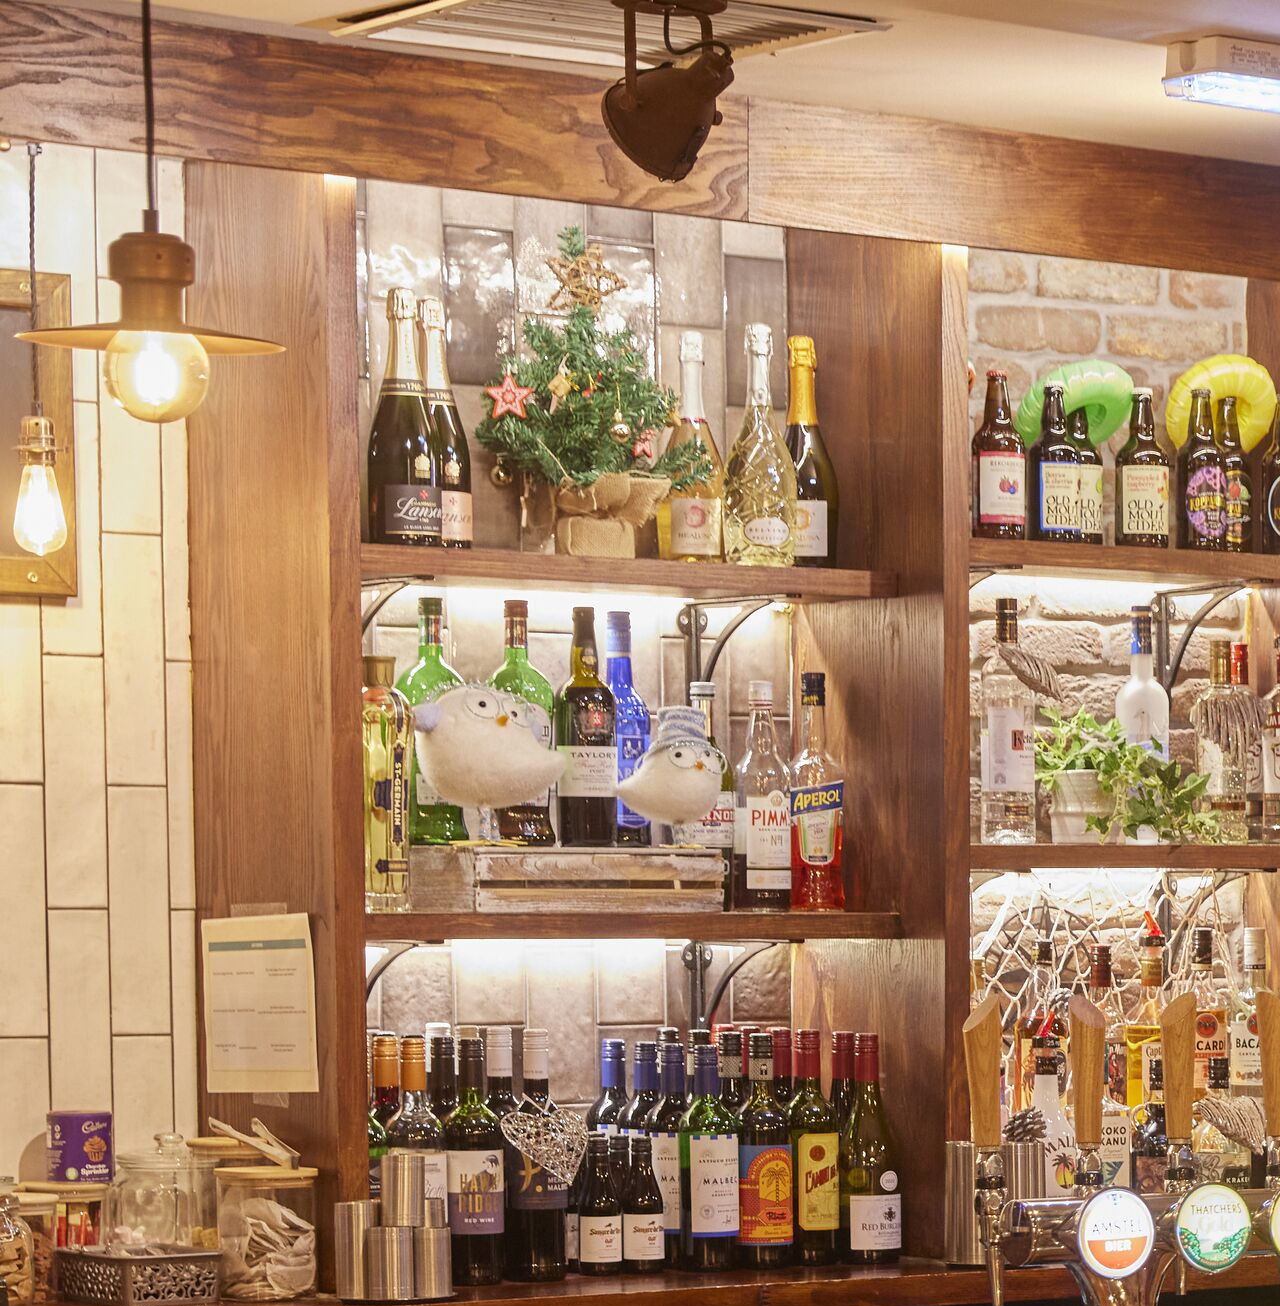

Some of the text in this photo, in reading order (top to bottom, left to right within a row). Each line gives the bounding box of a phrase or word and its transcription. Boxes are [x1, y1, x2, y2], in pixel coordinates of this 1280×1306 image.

[1046, 496, 1070, 507] OLD
[1127, 499, 1154, 511] OLD
[1045, 515, 1080, 527] CIDER
[1127, 520, 1165, 532] CIDER
[394, 761, 404, 827] ST-GERMAIN
[794, 787, 840, 812] APEROL
[1191, 1202, 1242, 1216] THATCHERS
[861, 1222, 880, 1235] RED
[1104, 1239, 1132, 1252] BIER
